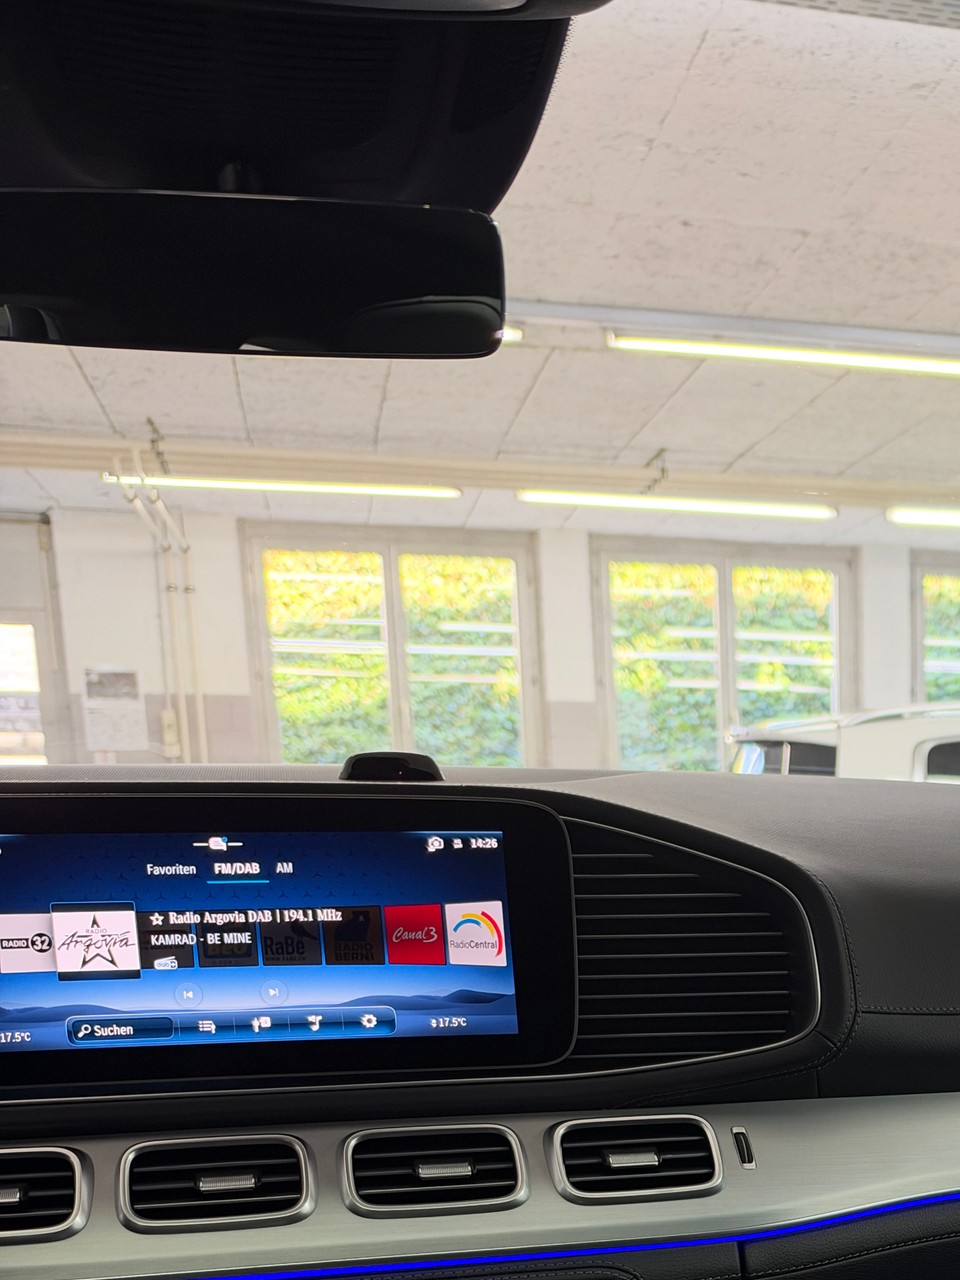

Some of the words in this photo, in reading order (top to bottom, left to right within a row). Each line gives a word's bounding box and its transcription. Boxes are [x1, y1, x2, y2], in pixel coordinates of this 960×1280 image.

[470, 838, 498, 849] 14:26
[146, 863, 197, 876] Favoriten
[214, 862, 260, 875] FM/DAB
[276, 862, 293, 874] AM
[169, 911, 200, 924] Radio
[203, 911, 245, 926] Argovia
[249, 910, 272, 923] DAB
[284, 909, 313, 922] 194.1
[317, 909, 342, 922] MHz
[2, 939, 27, 949] RADIO
[32, 935, 50, 951] 32
[151, 933, 197, 946] KAMRAD
[207, 933, 221, 944] BE
[223, 932, 252, 944] MINE
[438, 1017, 467, 1028] 17.5°C
[0, 1031, 32, 1043] 17.5°C
[93, 1024, 134, 1037] Suchen
